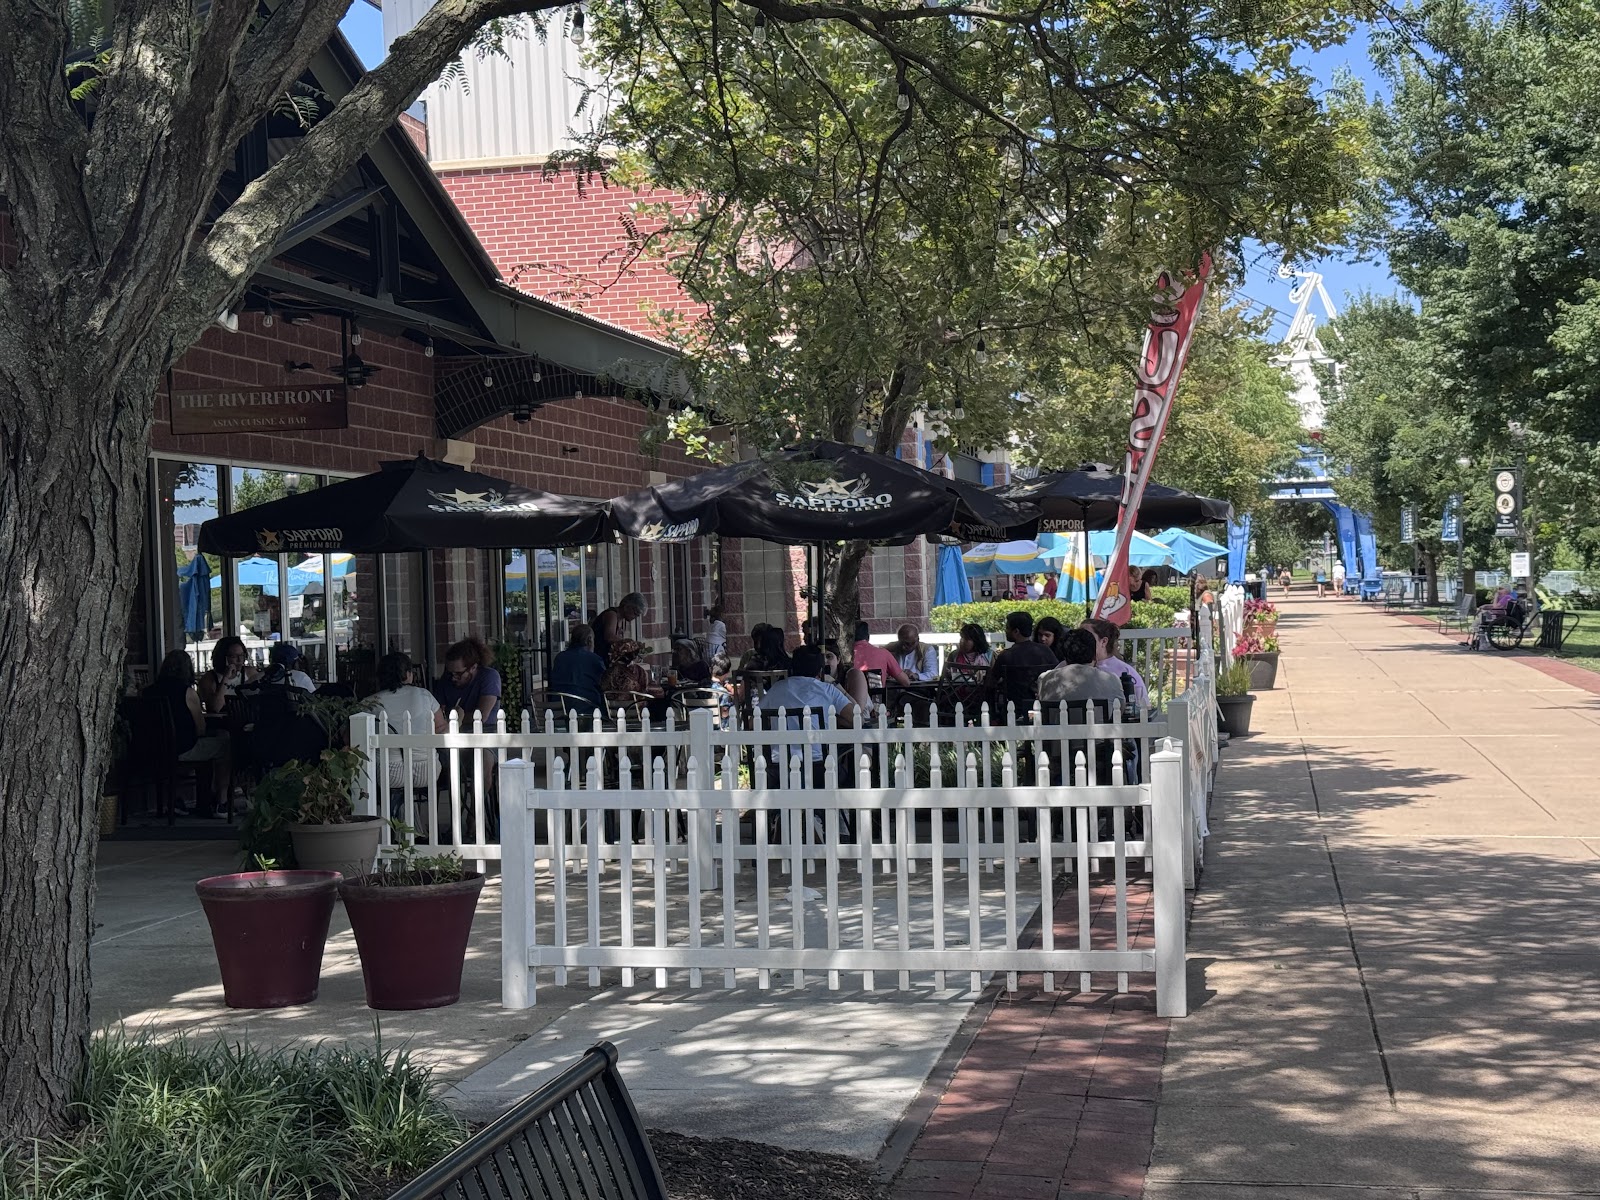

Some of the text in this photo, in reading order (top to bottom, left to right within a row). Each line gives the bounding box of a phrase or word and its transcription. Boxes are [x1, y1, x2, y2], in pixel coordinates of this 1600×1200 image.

[176, 389, 335, 409] THE RIVERFRONT
[212, 416, 307, 427] ASIAN CUISINE & BAR
[775, 492, 893, 509] SAPPORO
[778, 501, 892, 513] PREMIUM BEER
[282, 527, 343, 542] SAPPORO
[663, 517, 700, 537] SAPPORO
[289, 541, 341, 549] PREMIUM BEER
